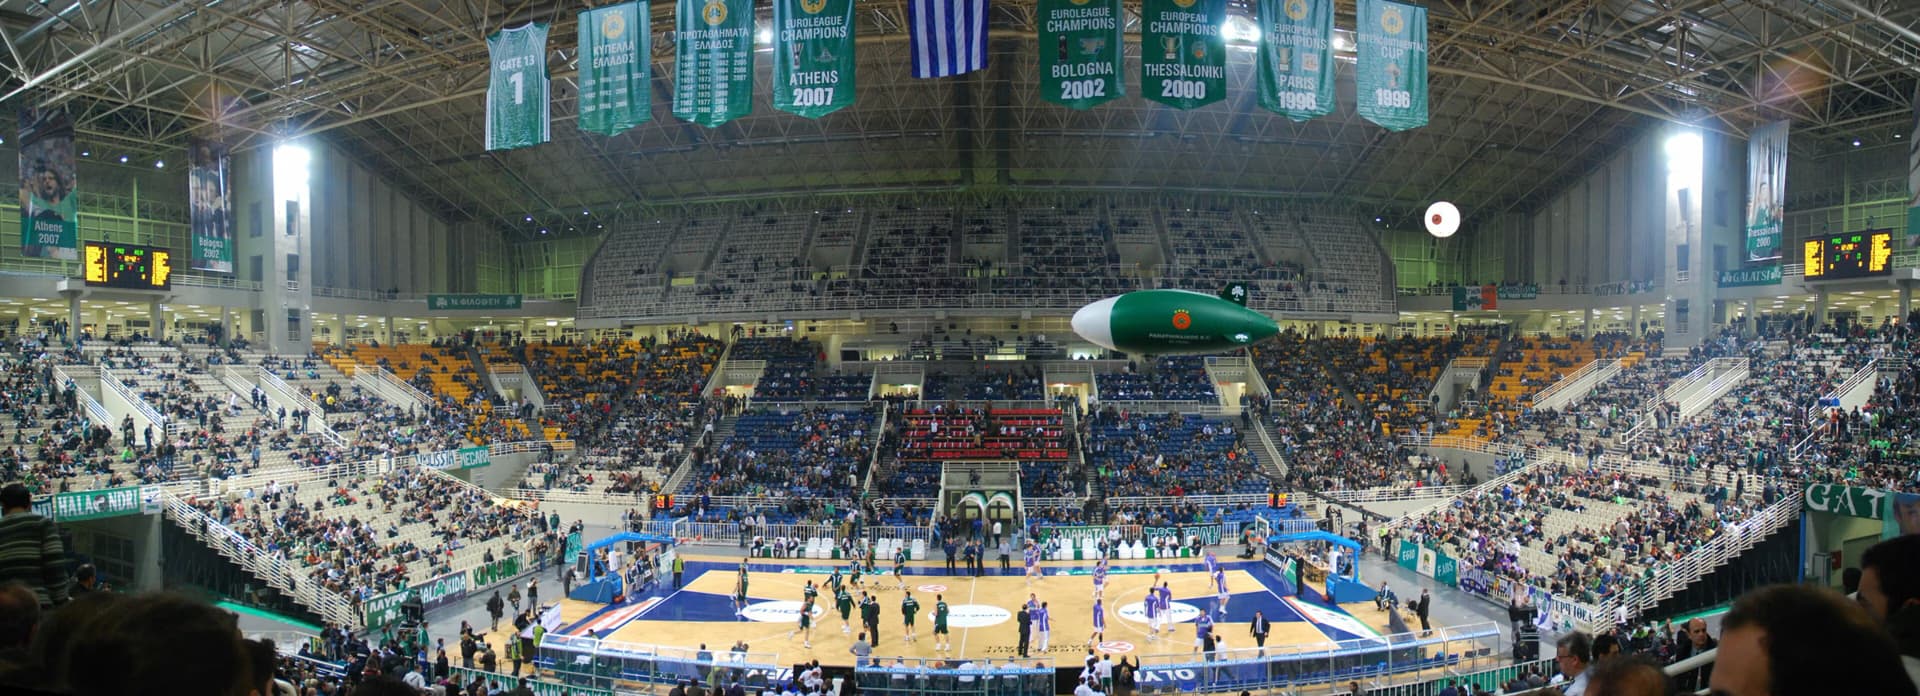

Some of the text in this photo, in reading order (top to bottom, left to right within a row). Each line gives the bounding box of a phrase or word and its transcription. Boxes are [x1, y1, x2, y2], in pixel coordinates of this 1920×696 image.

[1051, 7, 1111, 20] EUROLEAGUE
[1160, 11, 1208, 23] EUROPEAN
[786, 15, 843, 29] EUROLEAGUE
[1047, 17, 1116, 32] CHAMPIONS
[1150, 21, 1217, 36] CHAMPIONS
[781, 26, 848, 42] CHAMPIONS
[1265, 31, 1328, 50] CHAMPIONS
[694, 39, 734, 50] ΕΛΛΑΔΟΣ
[1381, 46, 1404, 59] CUP
[500, 54, 535, 71] GATE 13
[593, 53, 635, 69] ΕΛΛΑΔΟΣ
[1052, 61, 1114, 78] BOLOGNA
[1144, 63, 1224, 79] THESSALONIKI
[789, 70, 839, 87] ATHENS
[1279, 74, 1315, 90] PARIS
[510, 71, 524, 105] 1
[1061, 78, 1105, 99] 2002
[1161, 79, 1206, 99] 2000
[793, 87, 834, 106] 2007
[1375, 87, 1410, 109] 1996
[34, 220, 64, 233] Athens
[38, 232, 60, 245] 2007
[1133, 669, 1196, 682] OLY
